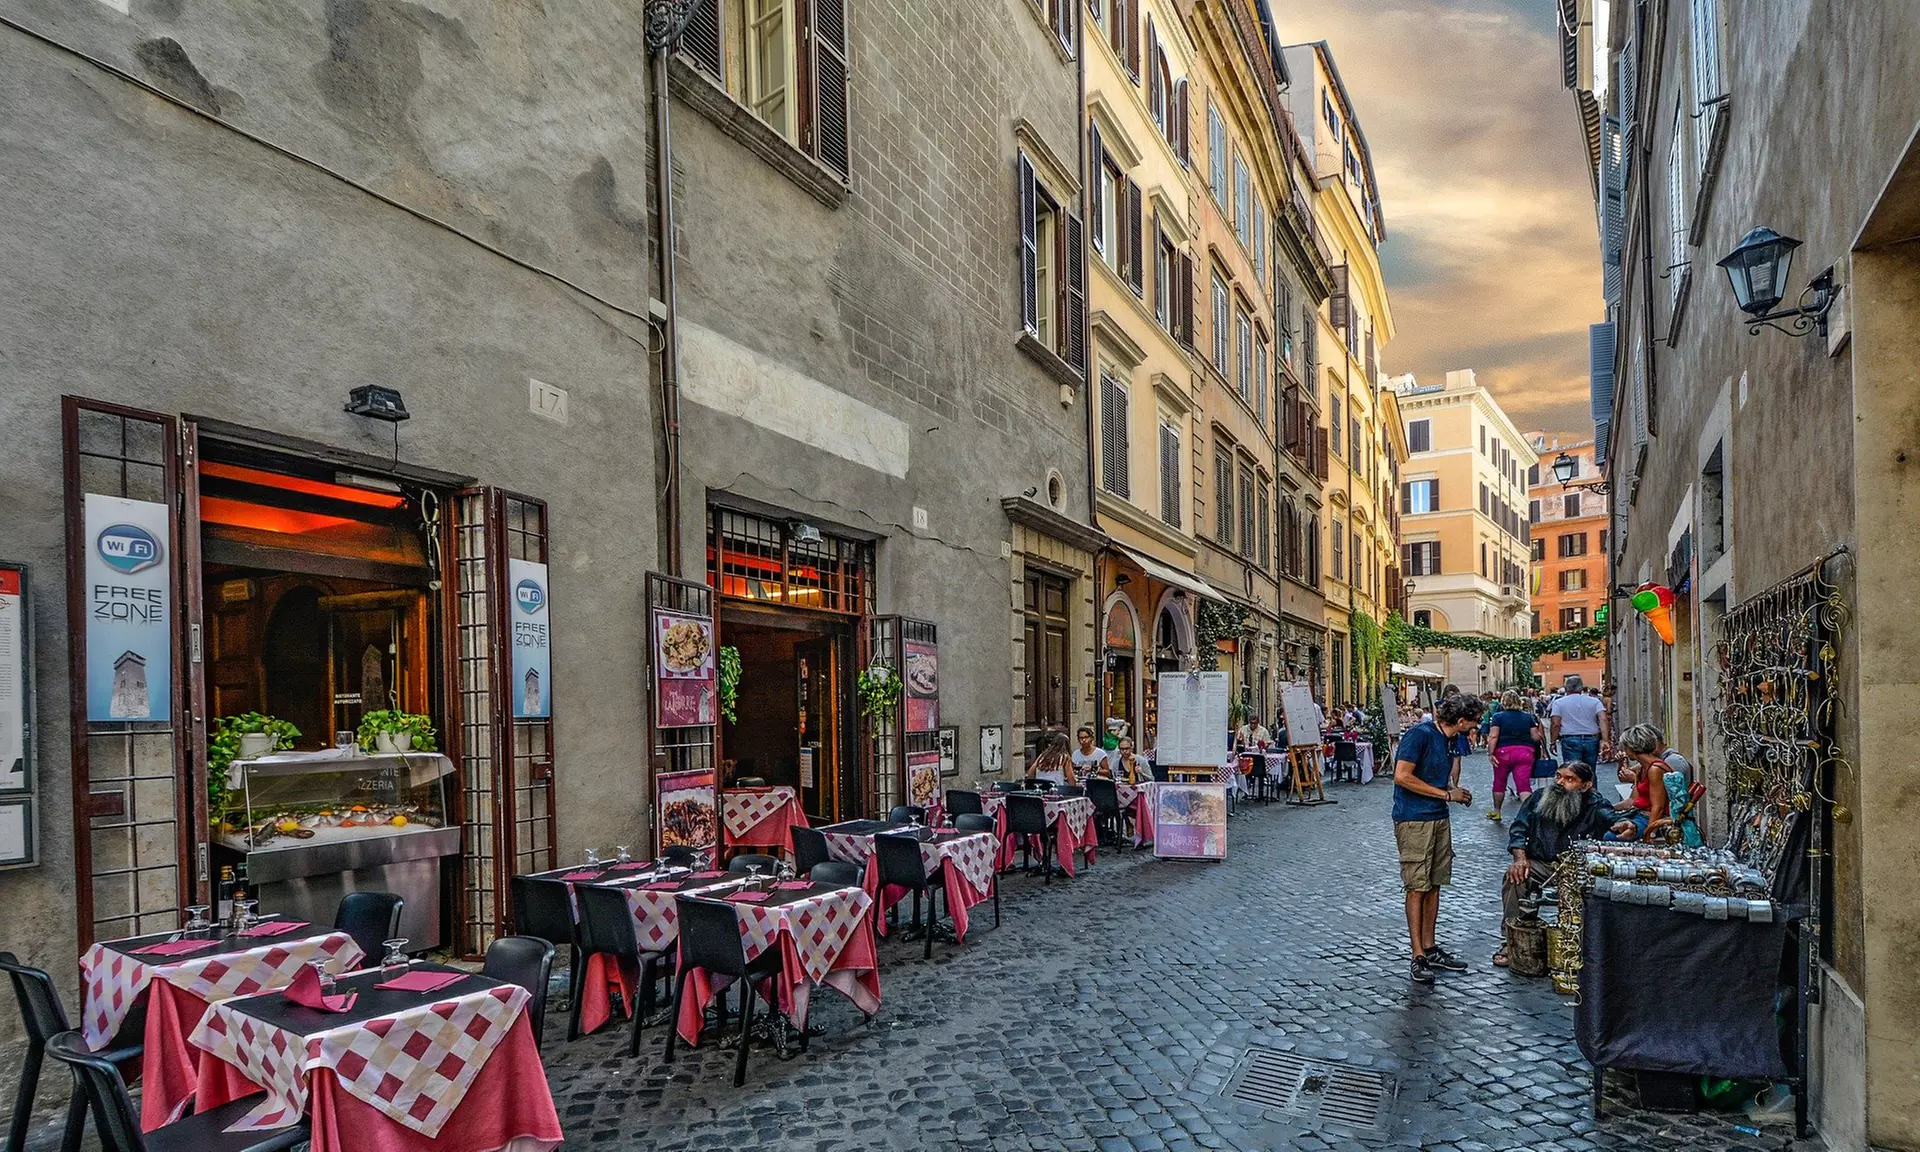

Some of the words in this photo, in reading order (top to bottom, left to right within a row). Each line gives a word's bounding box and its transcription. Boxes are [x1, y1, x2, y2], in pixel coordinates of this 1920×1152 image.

[916, 510, 926, 525] 18
[94, 584, 162, 605] FREE
[94, 600, 162, 619] ZONE
[515, 621, 546, 635] FREE
[515, 632, 546, 648] ZONE
